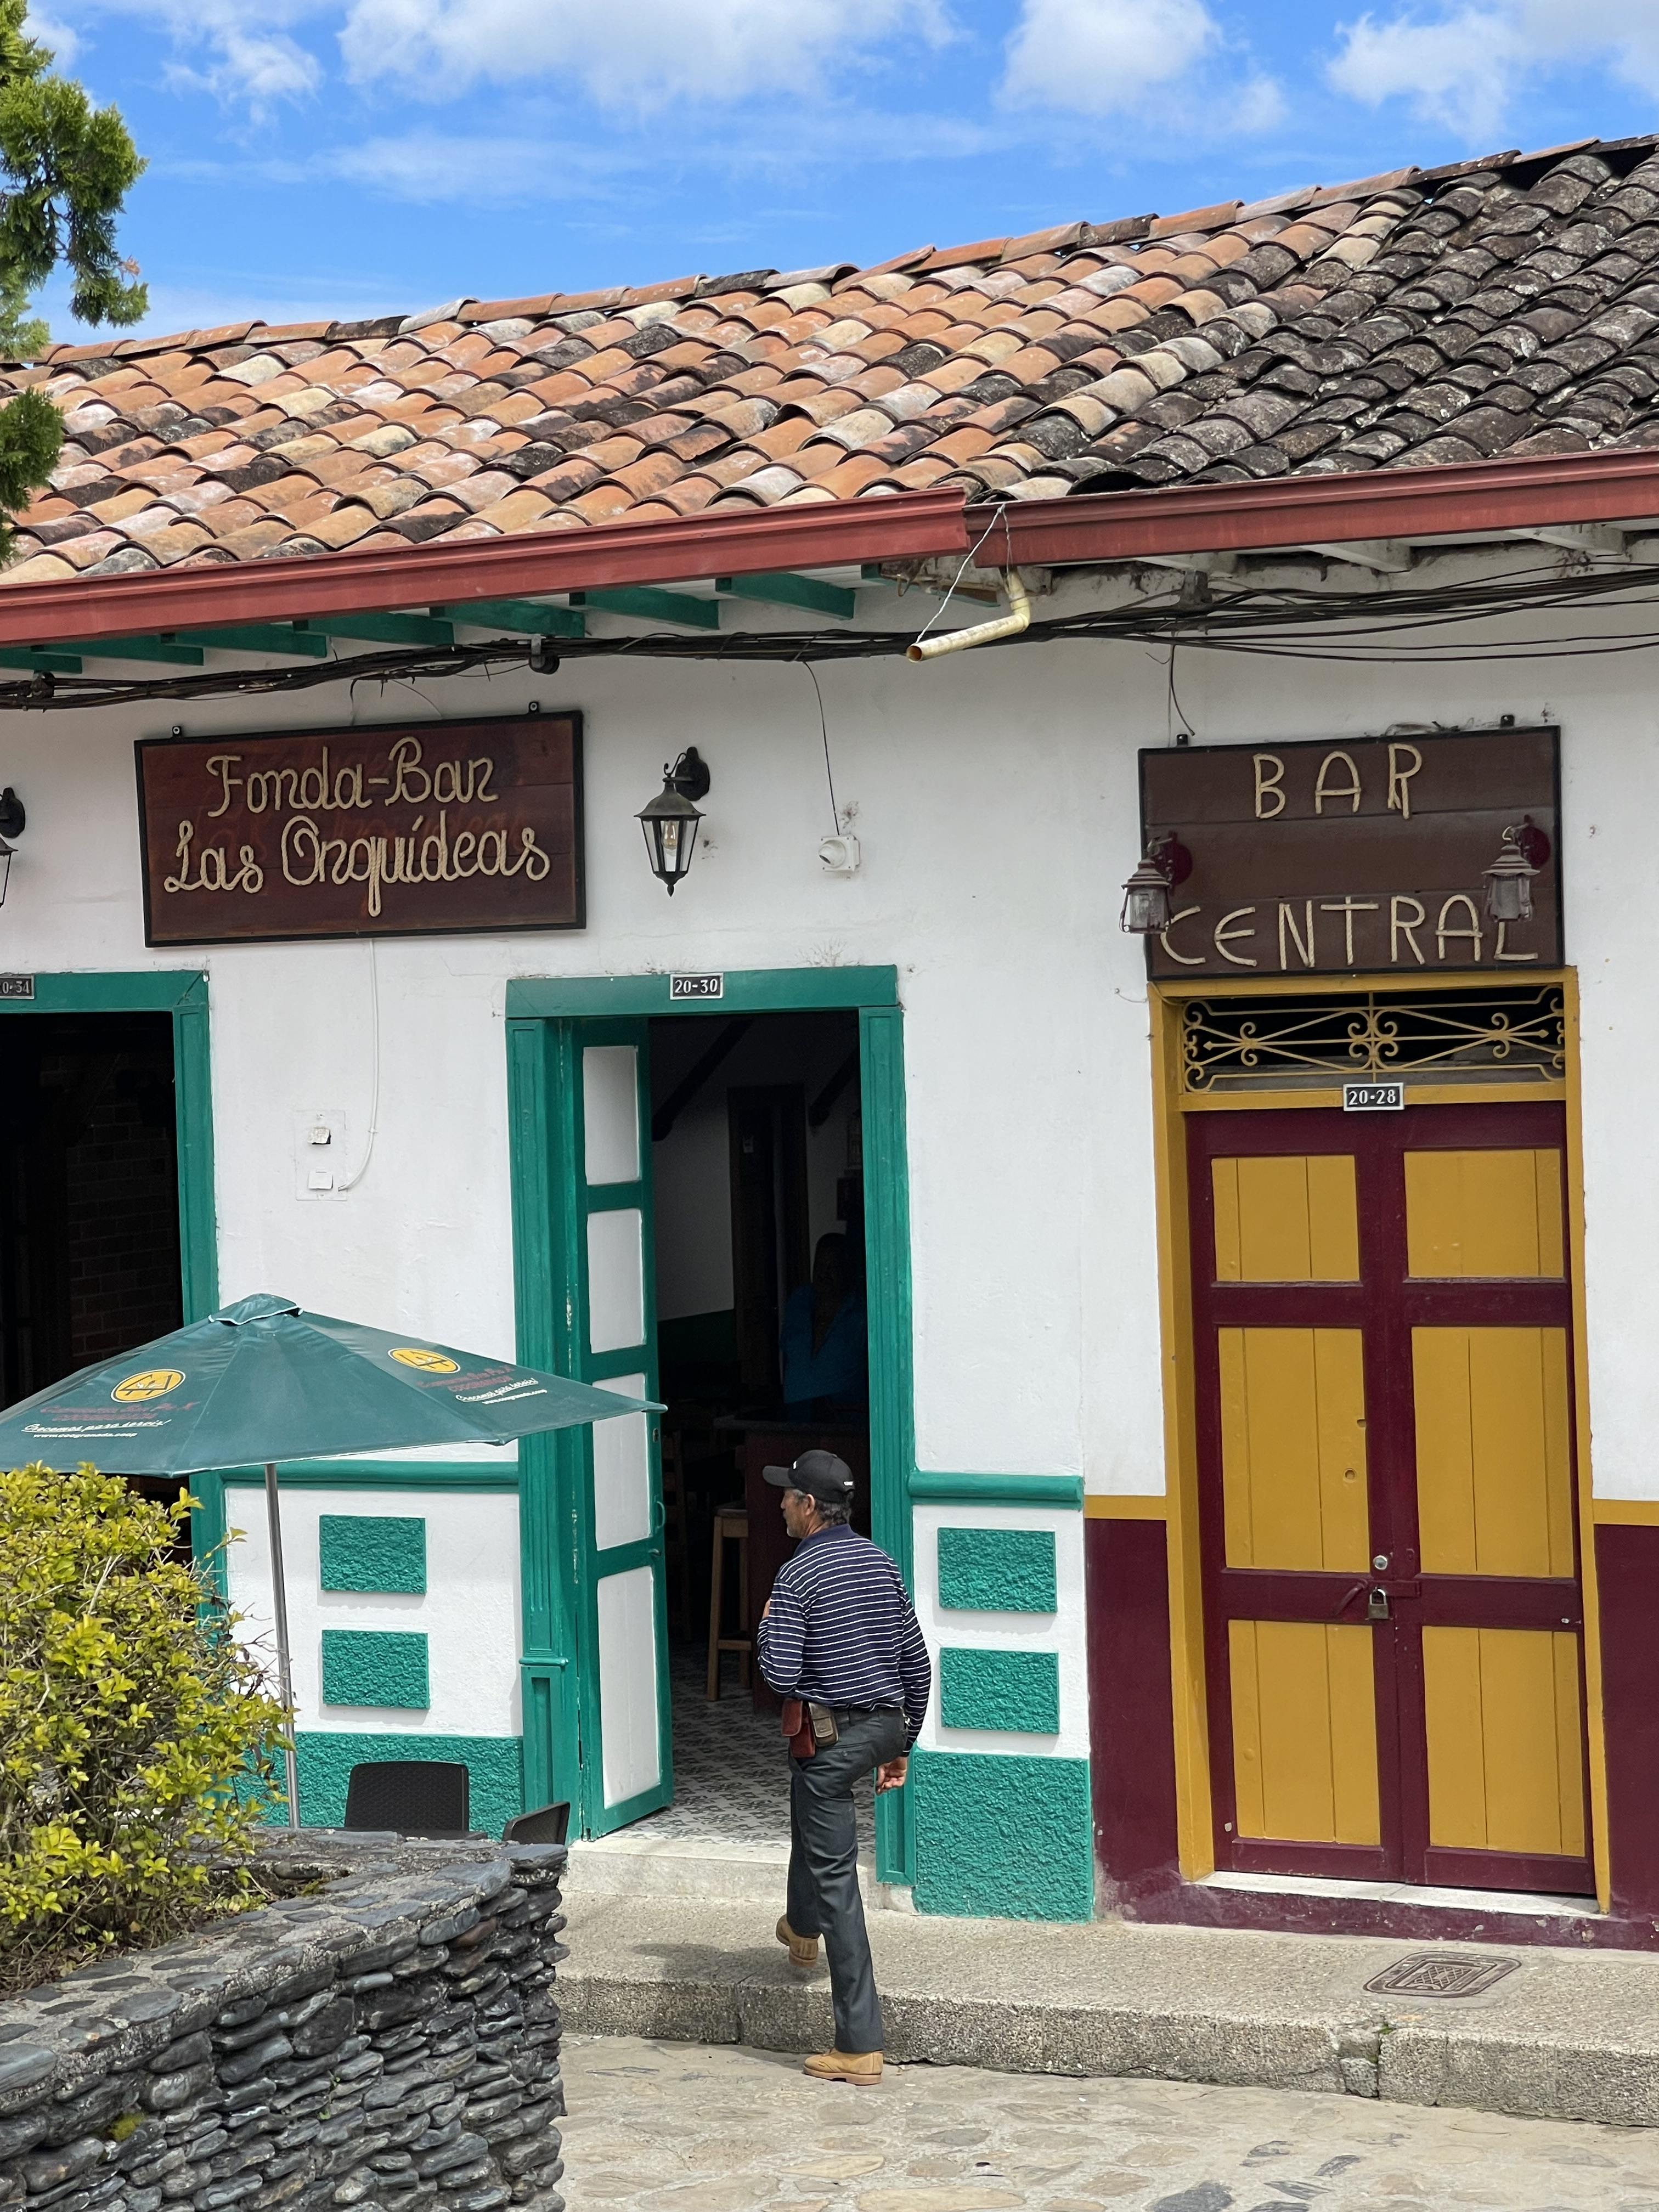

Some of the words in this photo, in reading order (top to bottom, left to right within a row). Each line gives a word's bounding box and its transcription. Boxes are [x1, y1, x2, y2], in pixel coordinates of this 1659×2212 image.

[206, 737, 499, 817] Fonda-Bar
[1252, 743, 1422, 820] BAR
[165, 820, 263, 894] Las
[281, 810, 550, 918] Orquídeas
[1160, 894, 1538, 970] CENTRAL
[0, 980, 30, 994] 0-34
[674, 978, 718, 994] 20-30
[1348, 1089, 1396, 1105] 20-28
